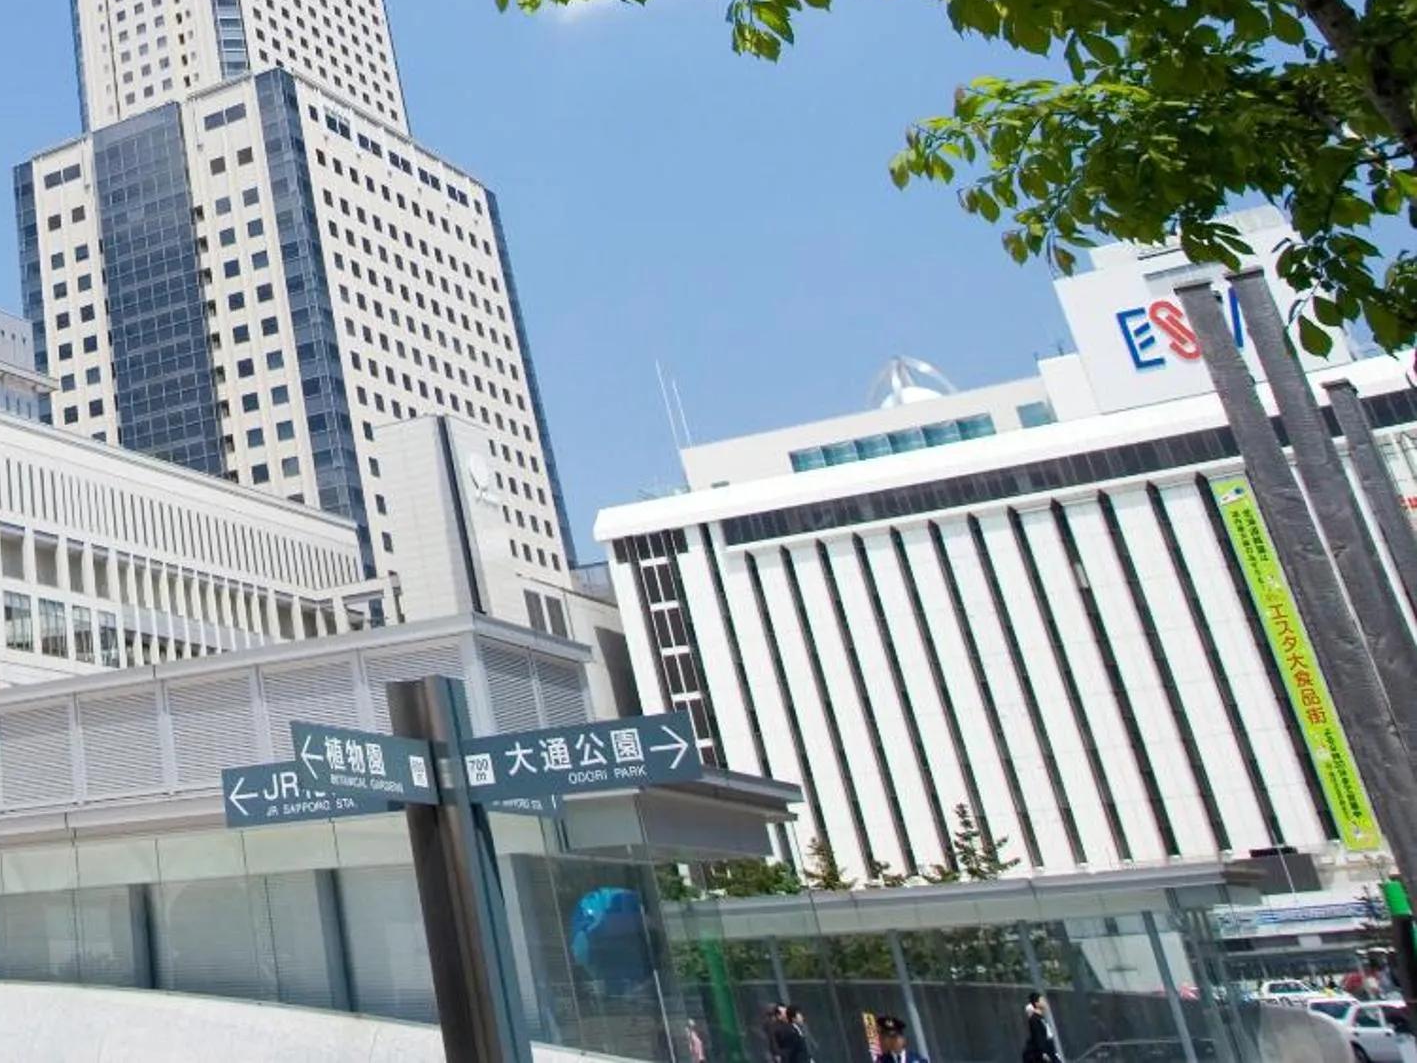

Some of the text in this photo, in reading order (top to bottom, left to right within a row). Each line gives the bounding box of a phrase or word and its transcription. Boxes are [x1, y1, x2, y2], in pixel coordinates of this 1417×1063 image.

[1268, 602, 1327, 724] エスタ大食品街
[323, 736, 386, 776] 植物園
[504, 728, 644, 776] 大通公園
[614, 764, 647, 779] PARK
[283, 800, 330, 815] SAPPORO
